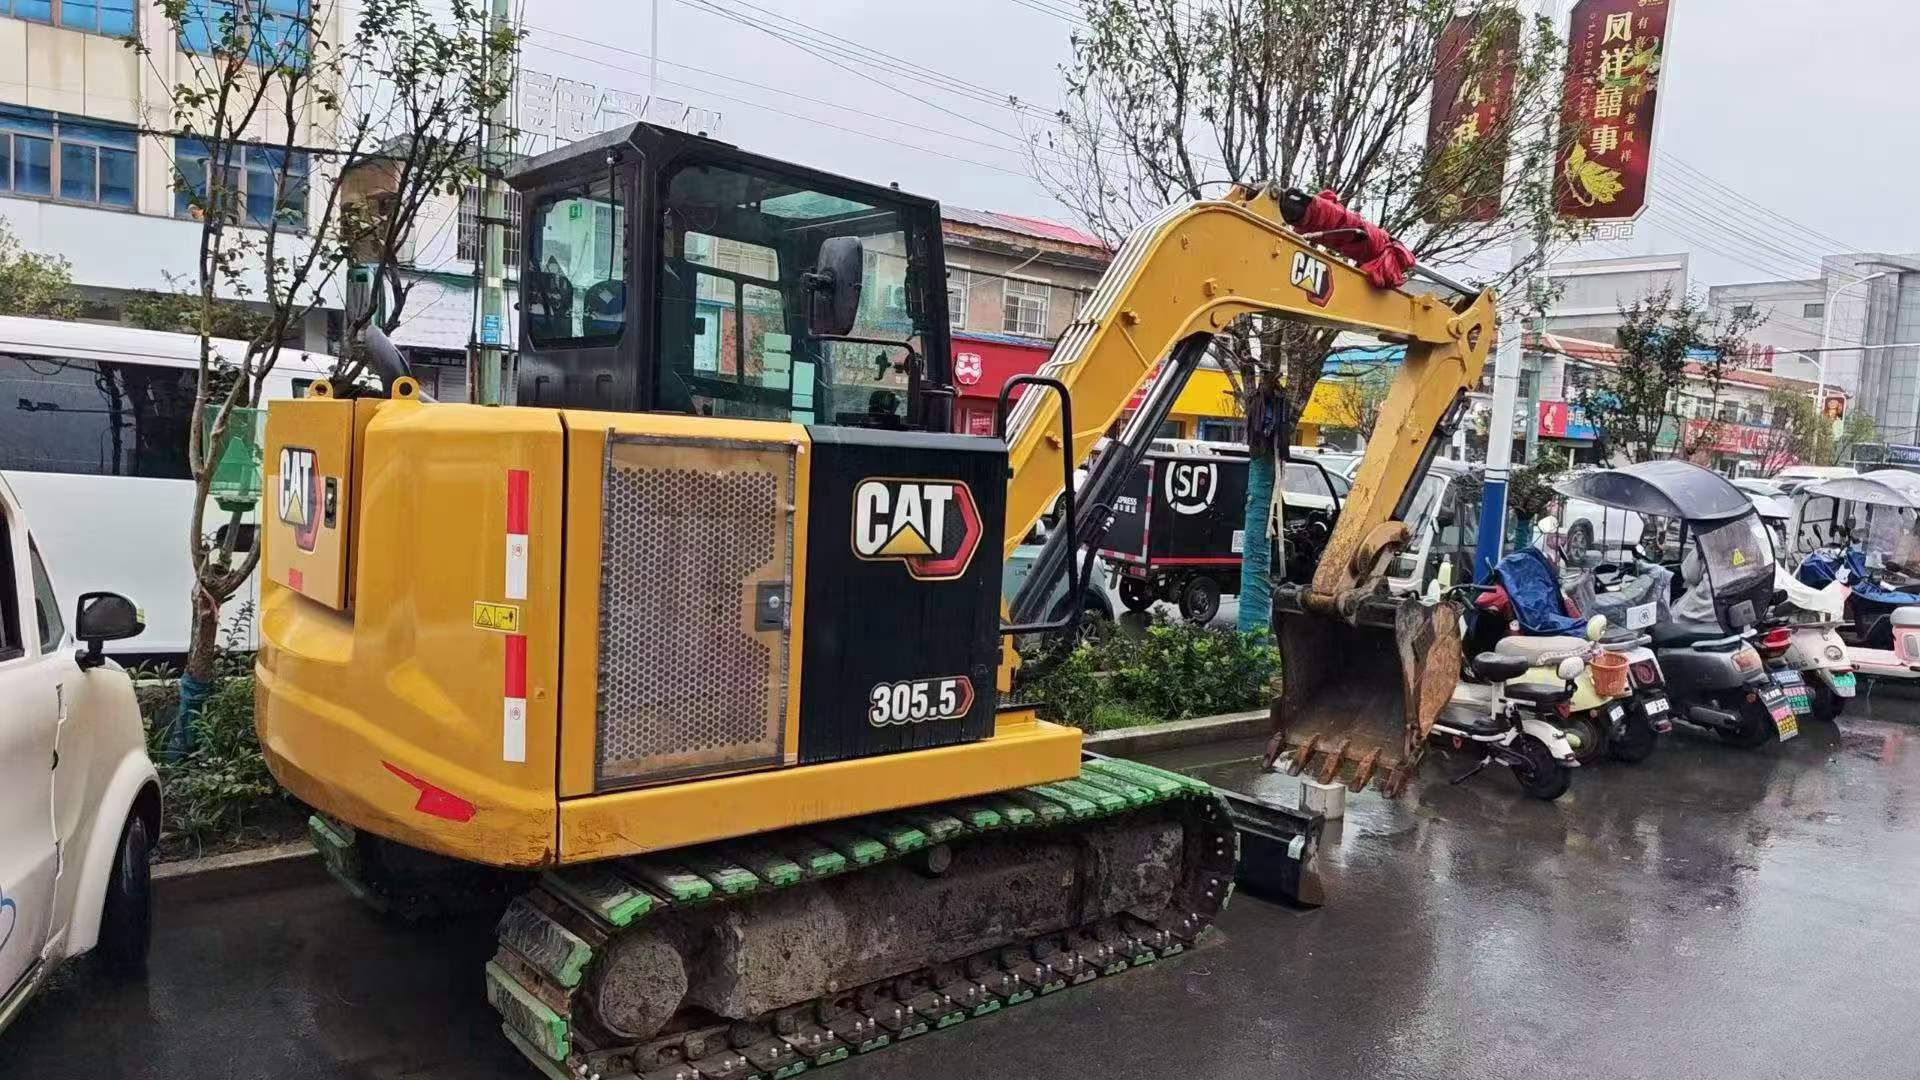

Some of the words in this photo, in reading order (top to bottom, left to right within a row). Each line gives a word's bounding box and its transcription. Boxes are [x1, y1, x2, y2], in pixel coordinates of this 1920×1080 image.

[1291, 251, 1327, 295] CAT
[279, 448, 312, 525] CAT
[856, 481, 953, 555] CAT
[872, 679, 957, 724] 305.5
